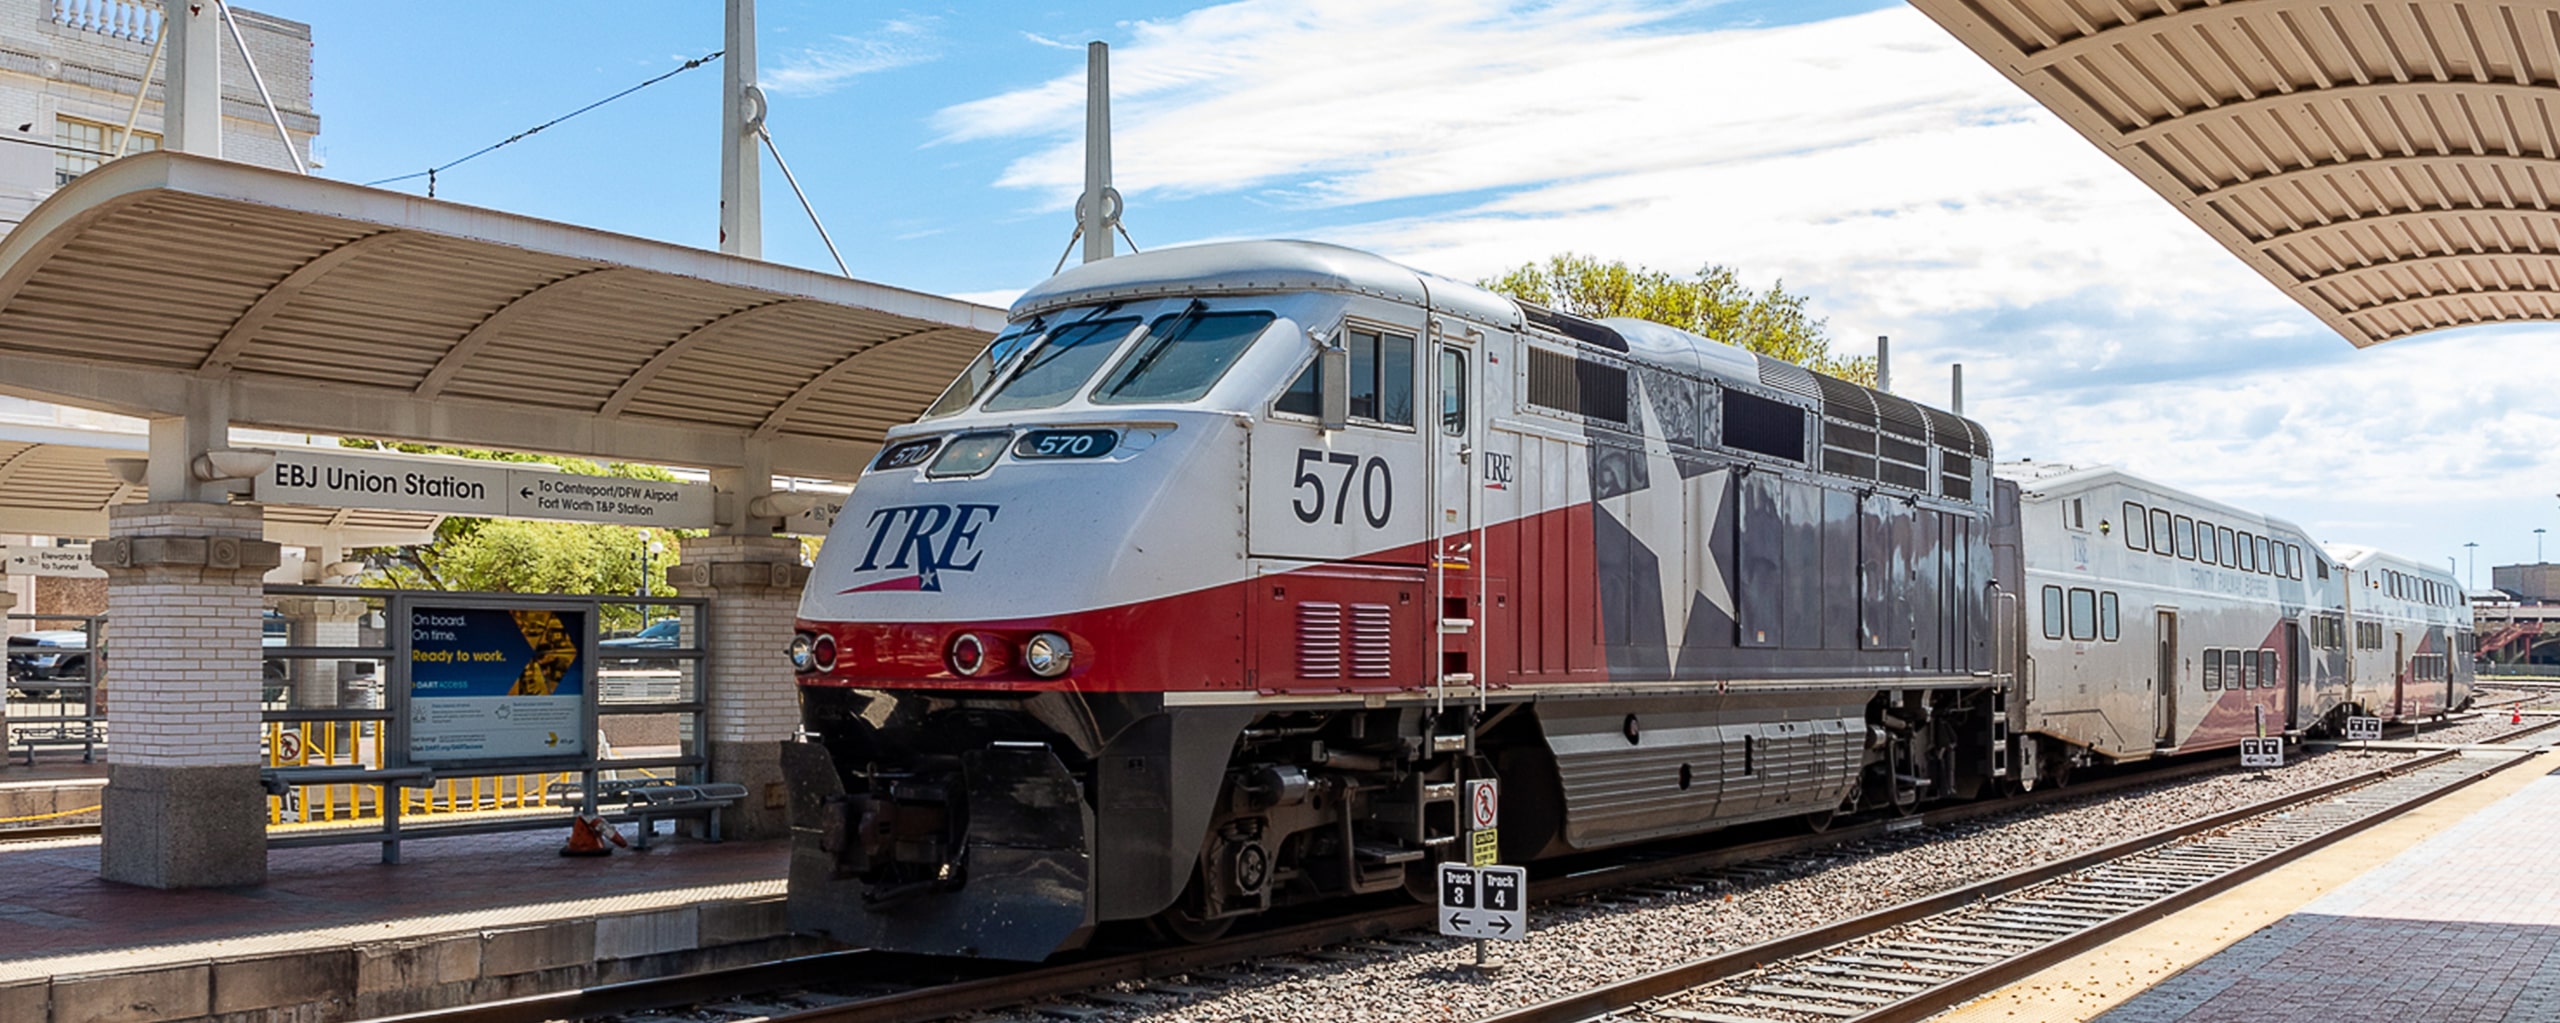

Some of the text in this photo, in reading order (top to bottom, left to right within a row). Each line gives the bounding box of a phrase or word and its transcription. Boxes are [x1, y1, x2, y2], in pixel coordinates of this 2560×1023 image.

[1036, 435, 1094, 455] 570
[889, 444, 929, 466] 570
[1484, 451, 1513, 485] TRE
[275, 463, 485, 500] EBJ Union Station
[1291, 447, 1393, 529] 570
[538, 480, 679, 503] To Centreport/DFW Airport
[538, 496, 654, 516] Fort Worth T&P Station
[41, 551, 75, 561] Elevator
[853, 503, 1000, 592] TRE
[41, 562, 79, 571] to Tunnel
[412, 614, 467, 626] On board.
[412, 629, 457, 641] On time.
[412, 650, 507, 664] Ready to work.
[1446, 871, 1472, 885] Track
[1486, 874, 1515, 888] Track
[1454, 887, 1464, 905] 3
[1494, 889, 1505, 908] 4
